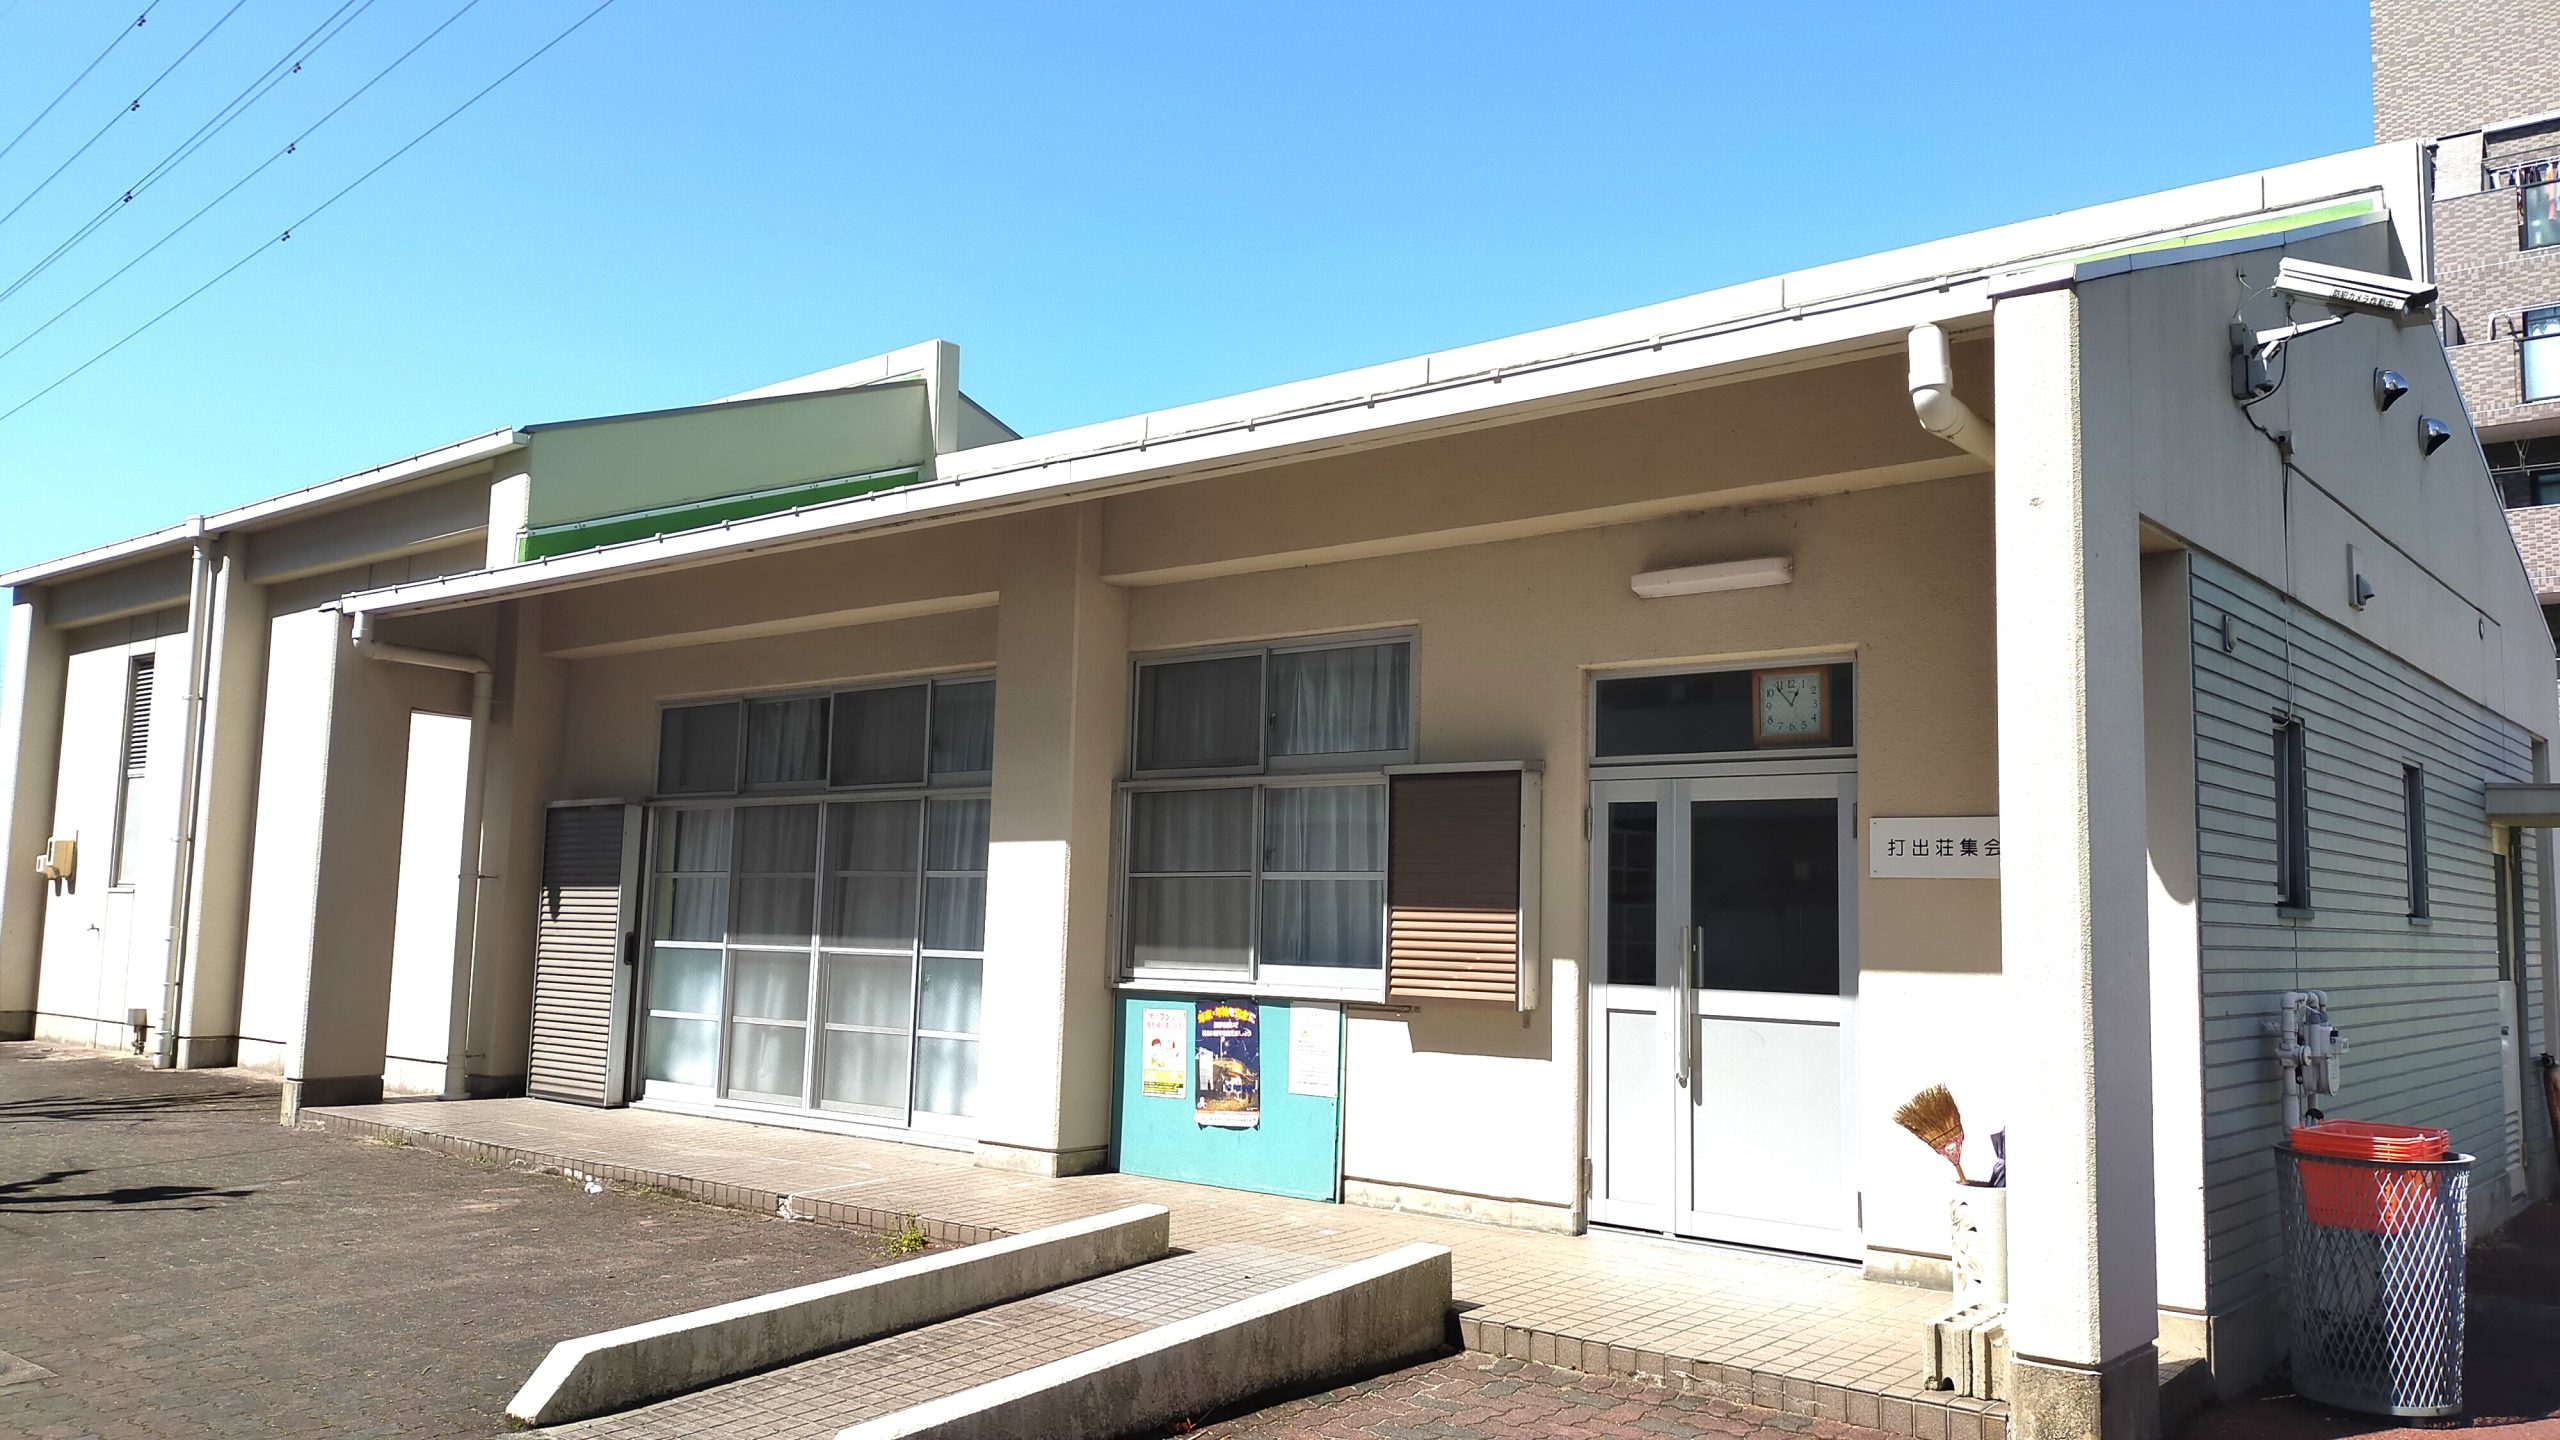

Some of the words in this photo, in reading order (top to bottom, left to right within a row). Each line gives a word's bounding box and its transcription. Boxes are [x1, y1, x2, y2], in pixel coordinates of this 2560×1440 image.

[1788, 680, 1795, 688] 12
[1767, 689, 1774, 697] 10
[1810, 686, 1816, 694] 2
[1766, 702, 1772, 711] 9
[1813, 700, 1818, 708] 3
[1767, 716, 1773, 725] 8
[1811, 714, 1817, 722] 4
[1778, 722, 1784, 730] 7
[1789, 722, 1796, 731] 6
[1801, 721, 1807, 729] 5
[1887, 838, 2000, 857] 打出荘集会
